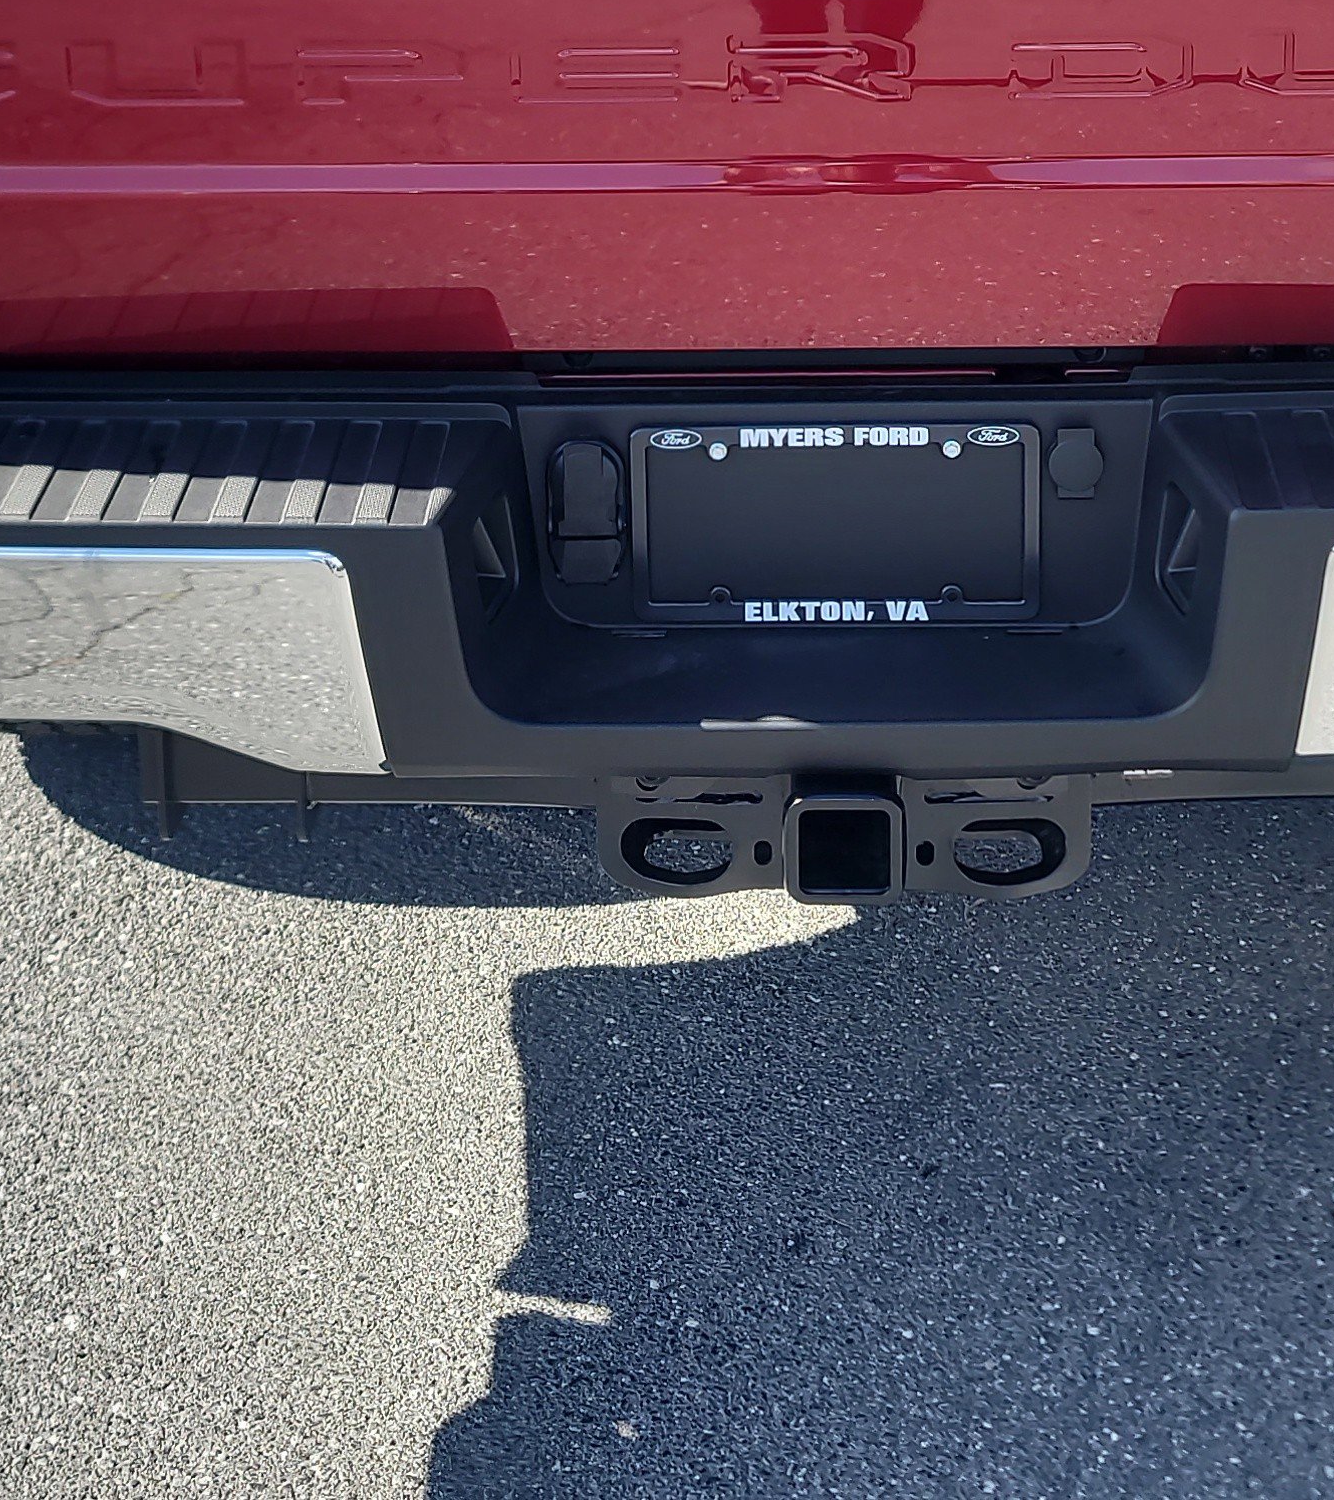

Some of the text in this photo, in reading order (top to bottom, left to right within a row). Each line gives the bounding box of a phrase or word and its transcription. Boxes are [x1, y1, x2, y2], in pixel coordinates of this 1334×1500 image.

[739, 426, 930, 448] MYERS FORD
[744, 600, 930, 622] ELKTON, VA
